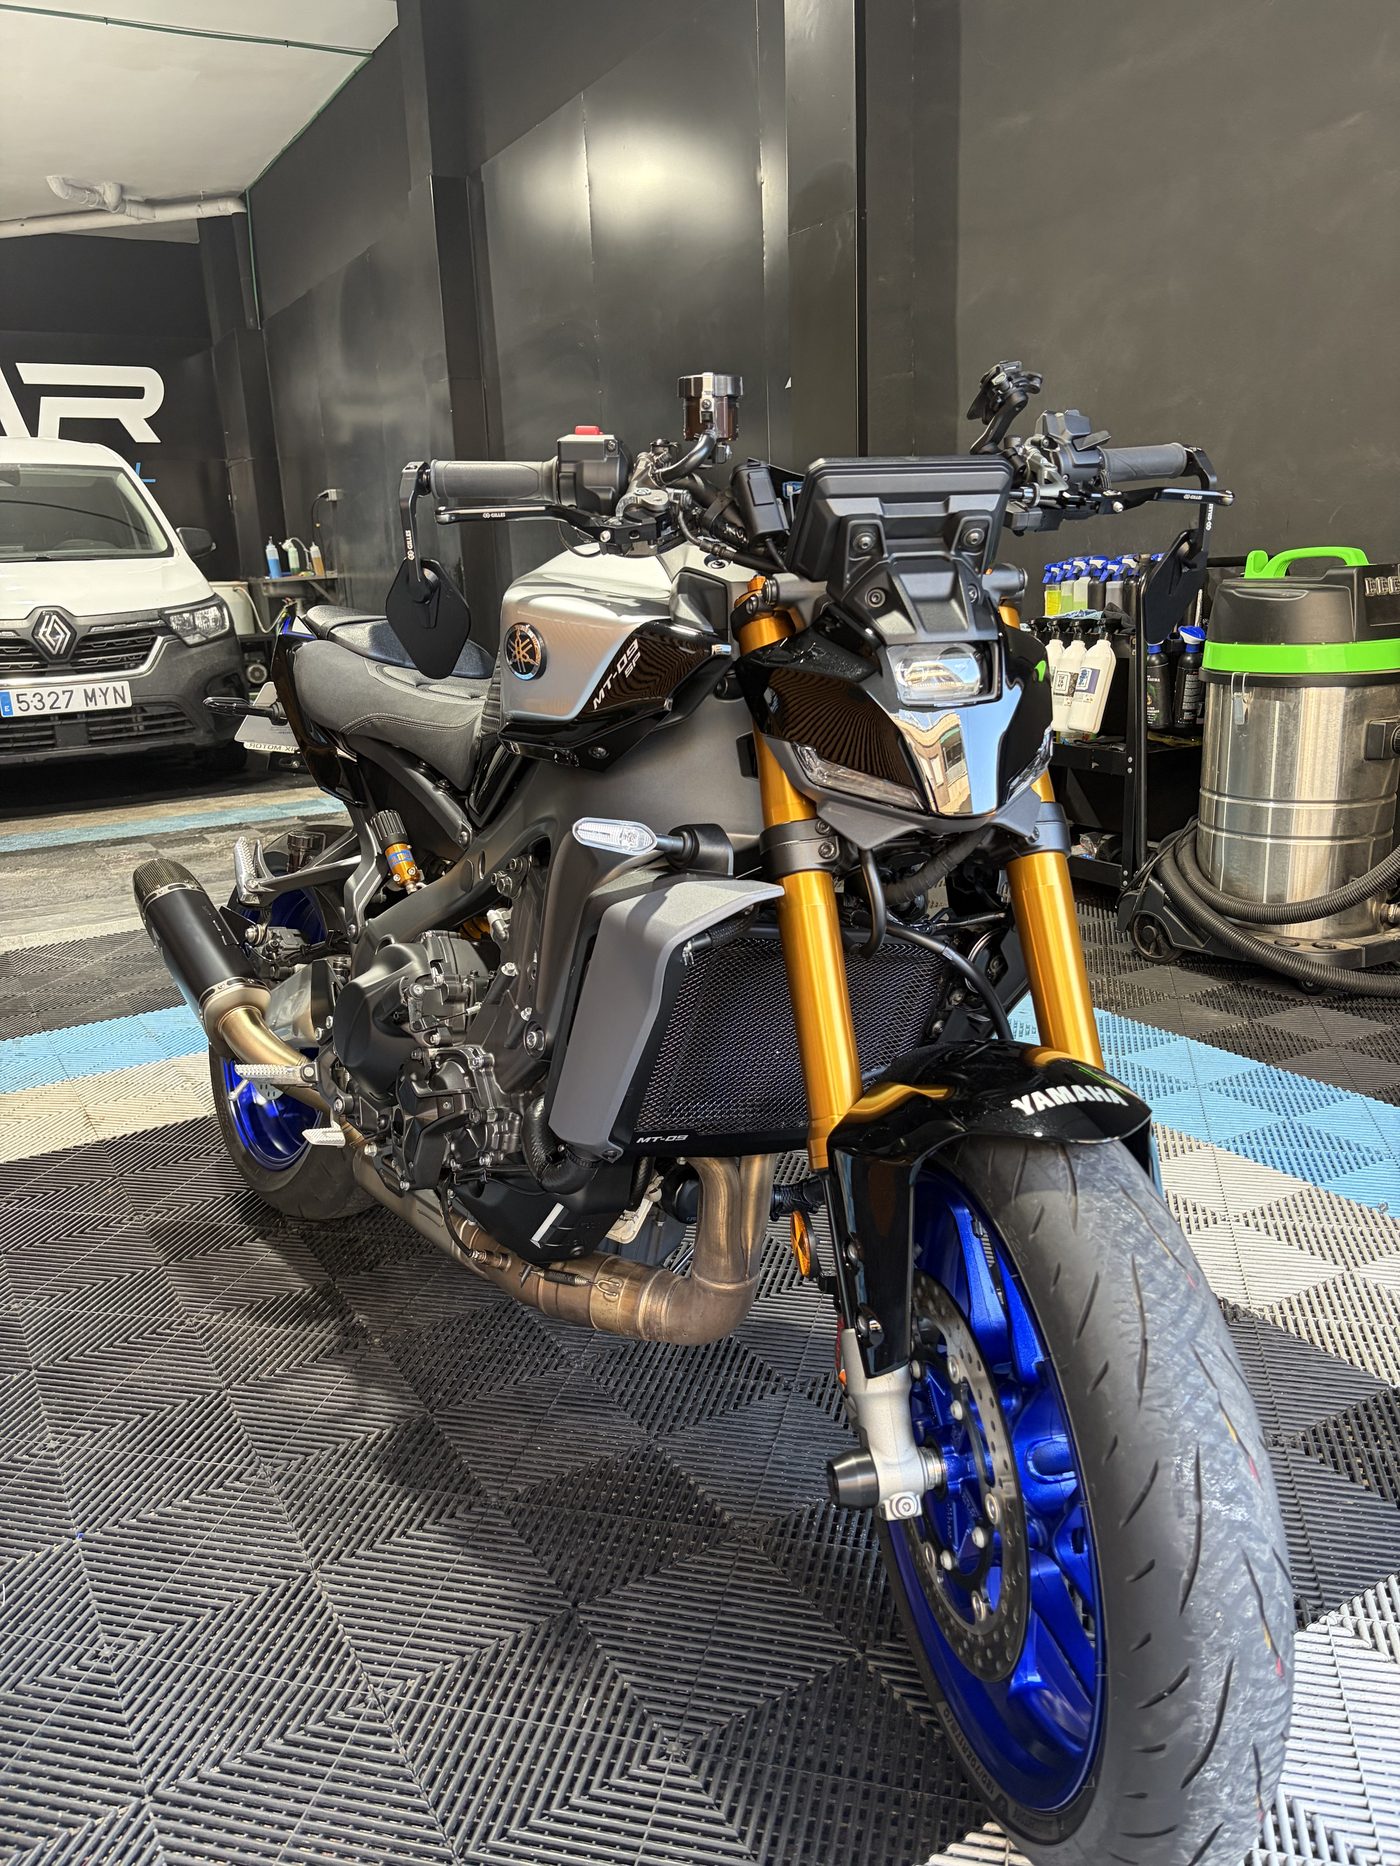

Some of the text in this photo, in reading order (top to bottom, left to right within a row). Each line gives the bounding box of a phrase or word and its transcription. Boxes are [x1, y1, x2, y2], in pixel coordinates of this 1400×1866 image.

[405, 530, 414, 550] GILLES
[593, 638, 639, 710] MT-09
[624, 651, 641, 678] SP
[16, 686, 127, 712] 5327 MYN
[1010, 1084, 1129, 1117] YAMAHA
[636, 1134, 689, 1144] MT-09
